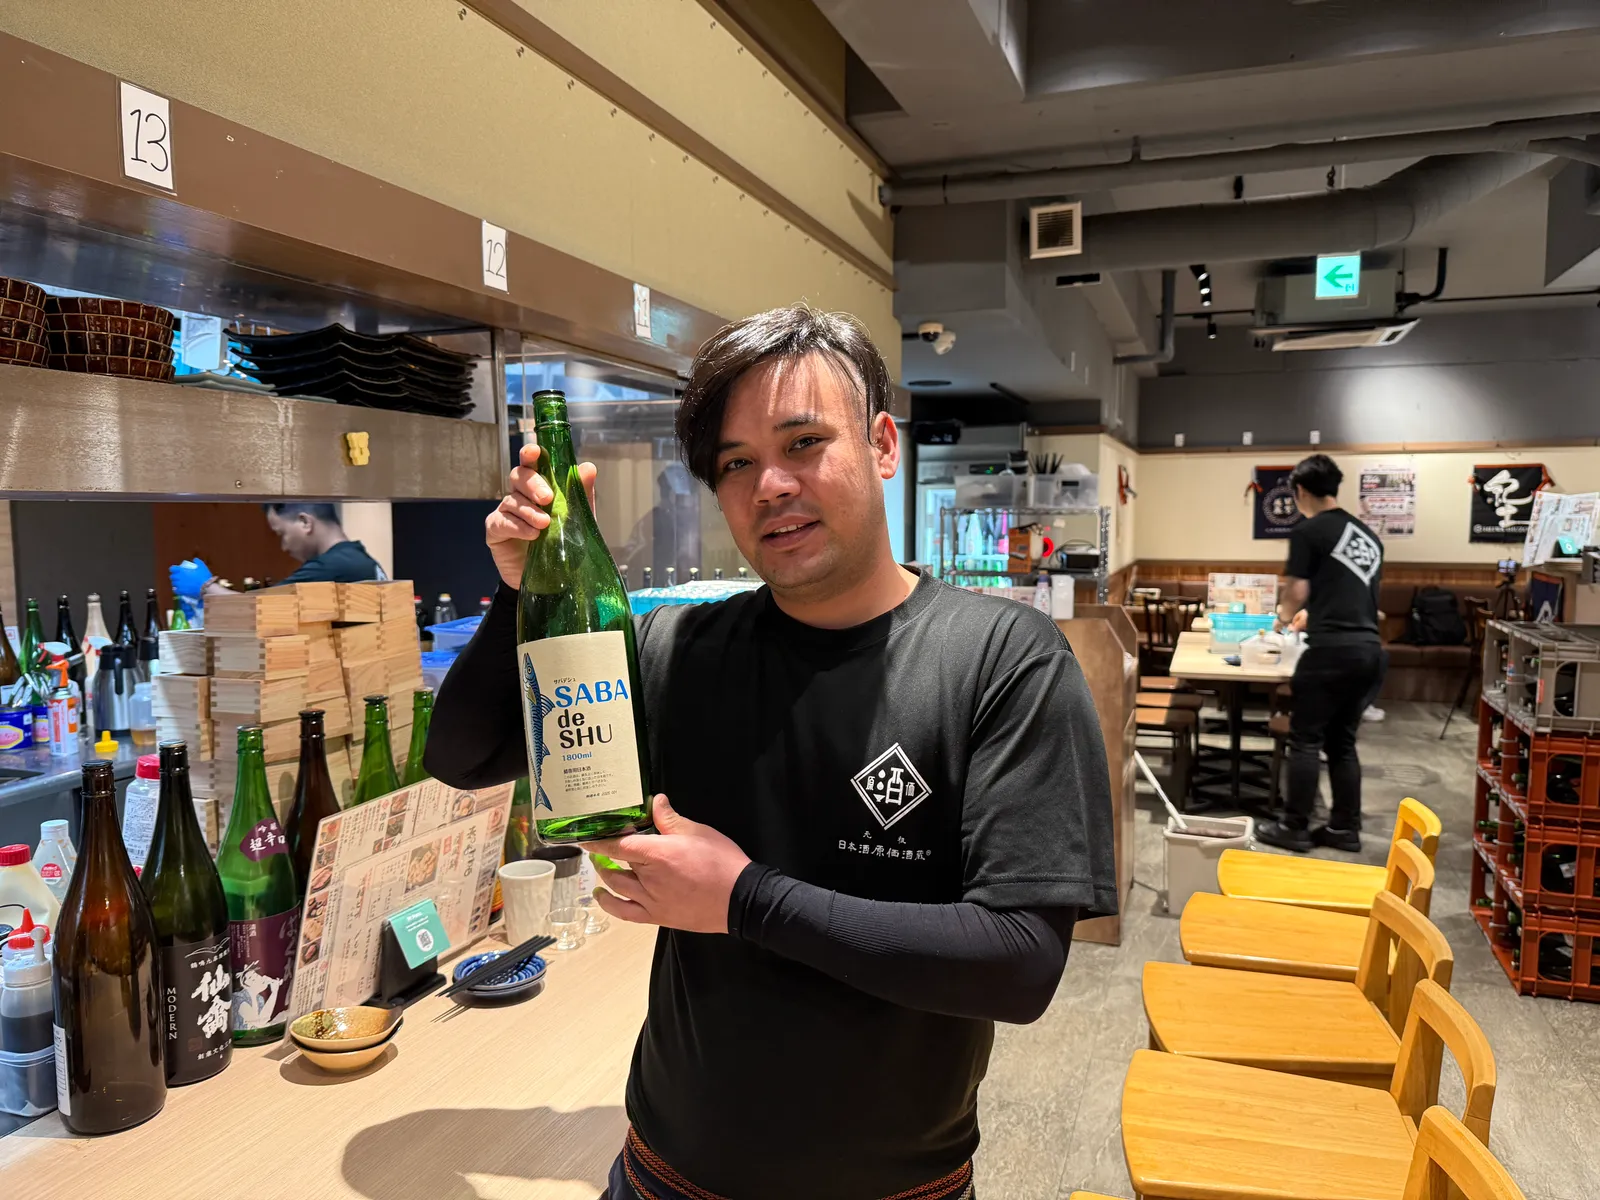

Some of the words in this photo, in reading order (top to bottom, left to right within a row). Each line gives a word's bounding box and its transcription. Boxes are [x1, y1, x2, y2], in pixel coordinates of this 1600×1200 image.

[130, 108, 168, 172] 13
[485, 238, 506, 278] 12
[555, 679, 628, 708] SABA
[557, 709, 585, 728] de
[560, 723, 613, 749] SHU
[562, 752, 592, 762] 1800ml
[249, 831, 286, 852] 超辛口
[167, 988, 178, 1040] MODERN
